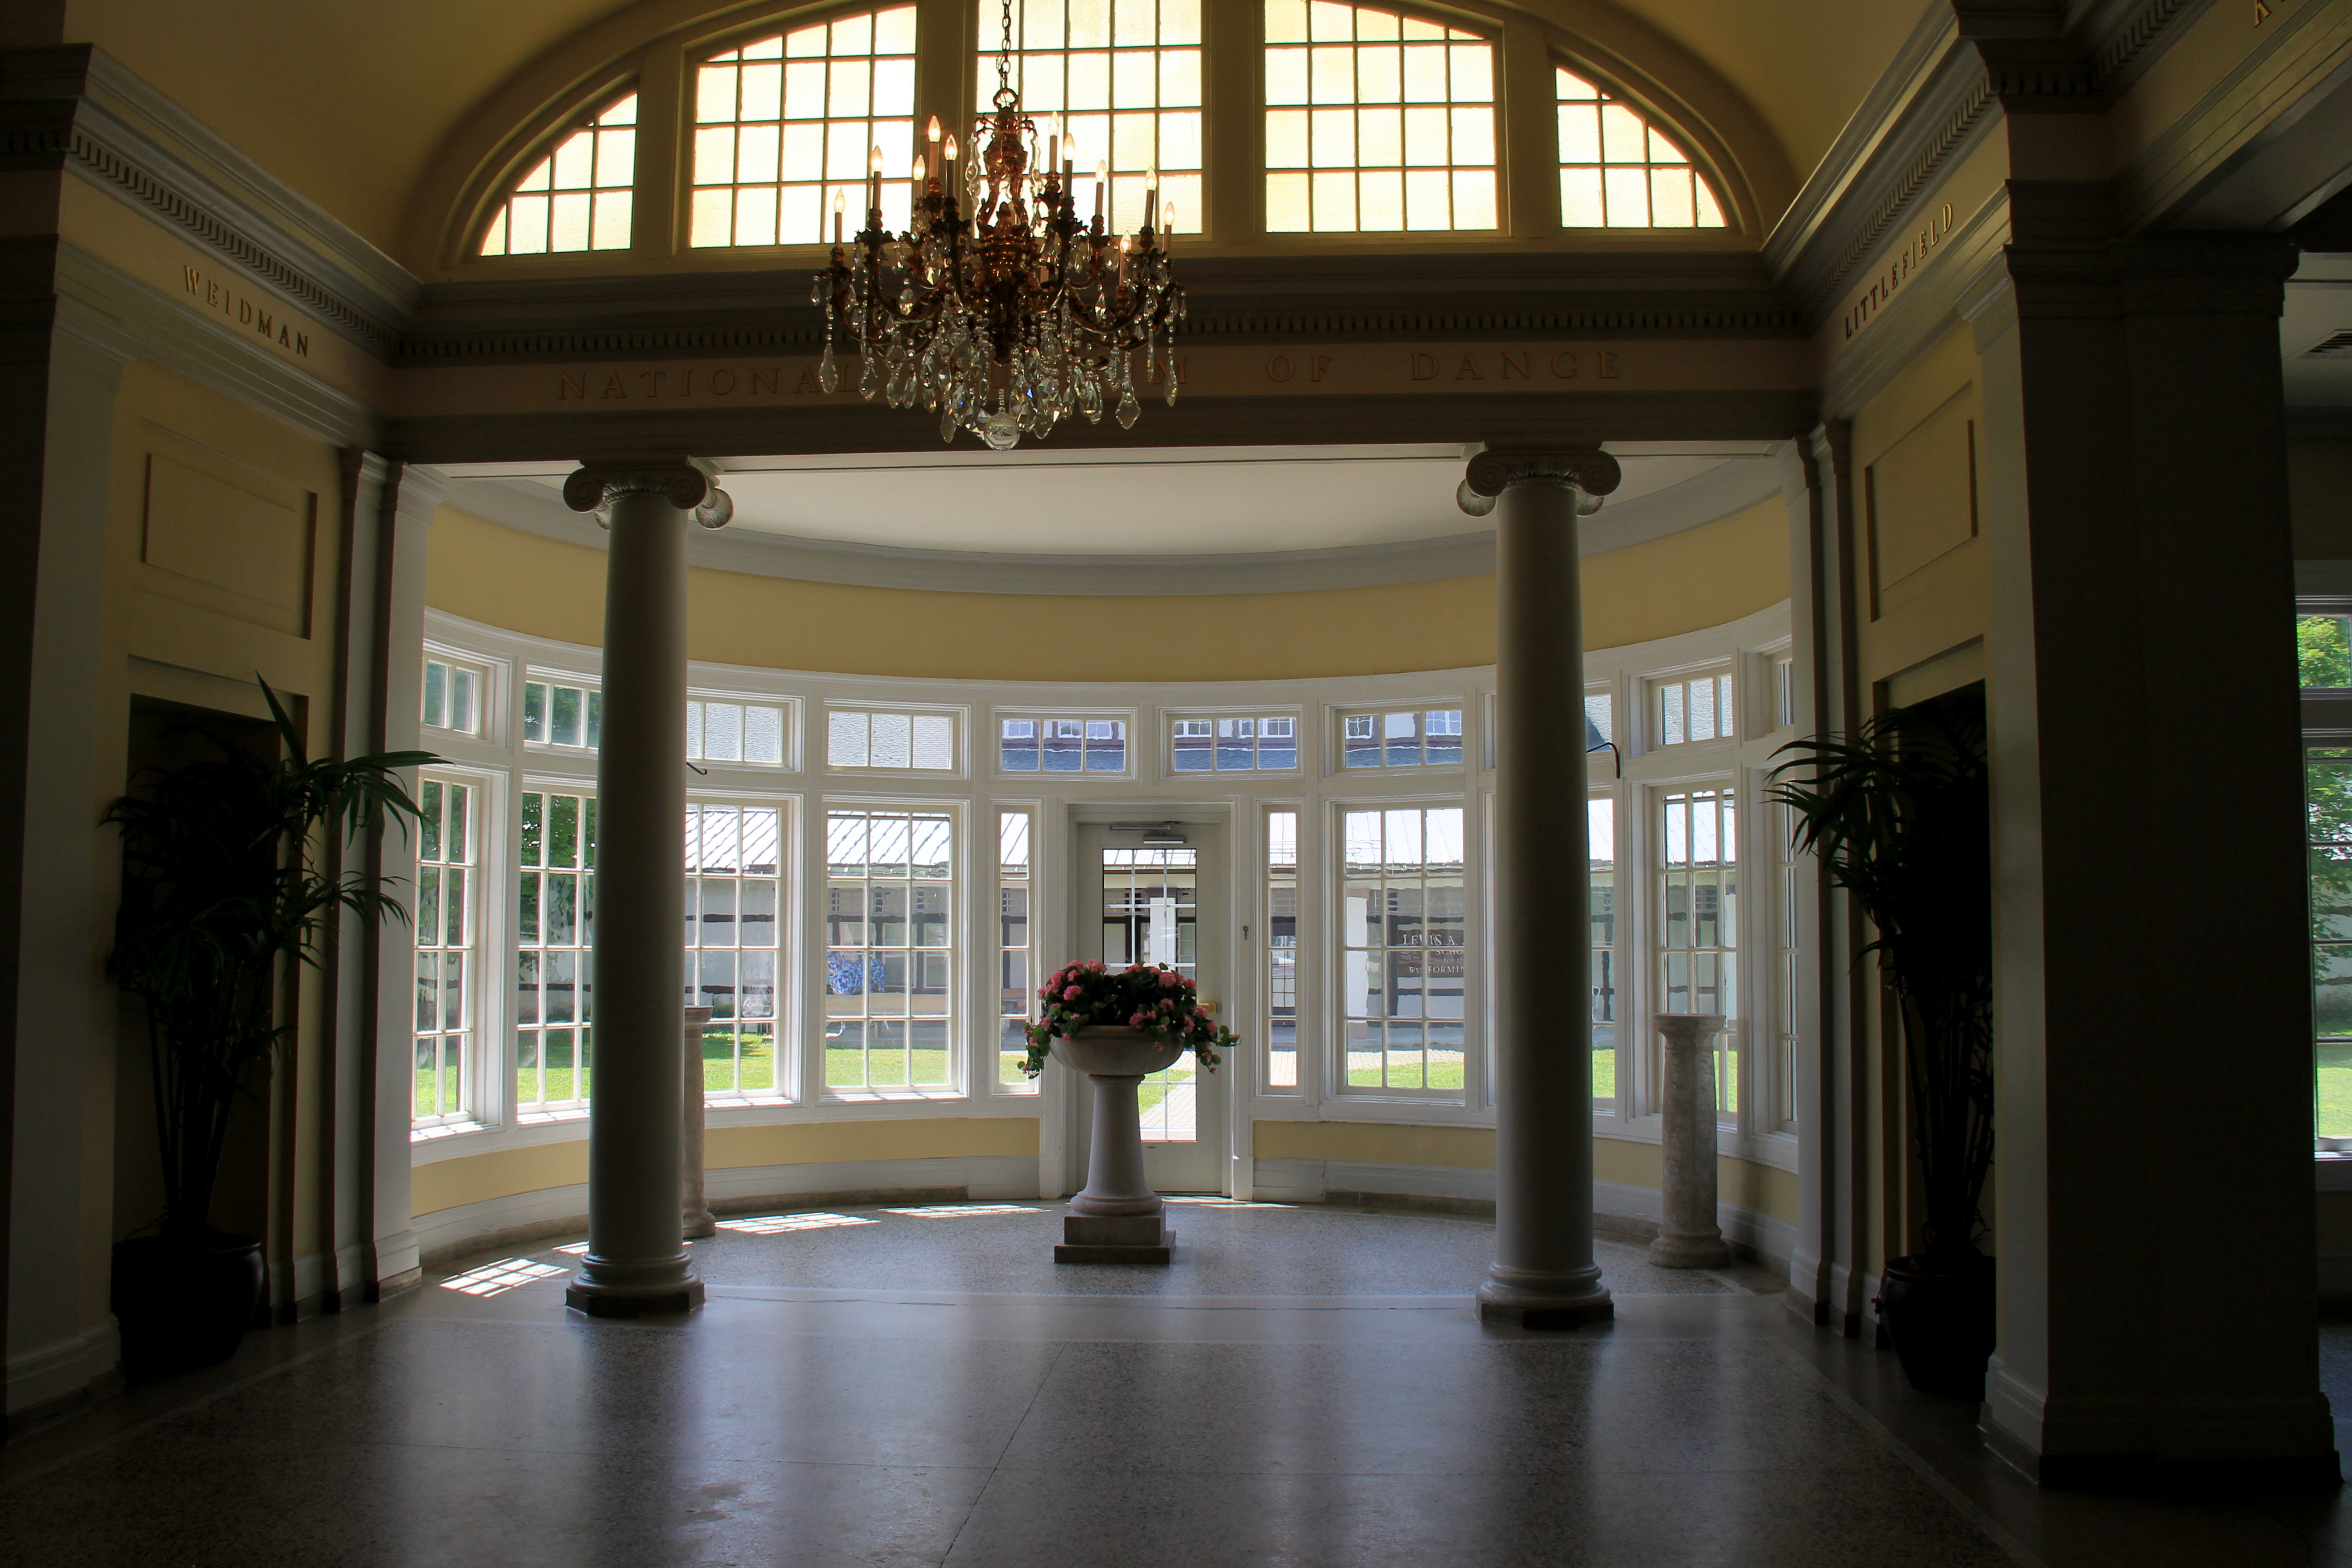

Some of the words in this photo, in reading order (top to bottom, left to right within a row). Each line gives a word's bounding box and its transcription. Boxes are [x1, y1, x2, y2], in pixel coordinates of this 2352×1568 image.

[184, 265, 309, 358] WEIDMAN
[1845, 203, 1953, 339] LITTLEFIELD
[558, 365, 858, 400] NATIONAL
[1267, 355, 1331, 382] OF
[1411, 352, 1620, 380] DANCE
